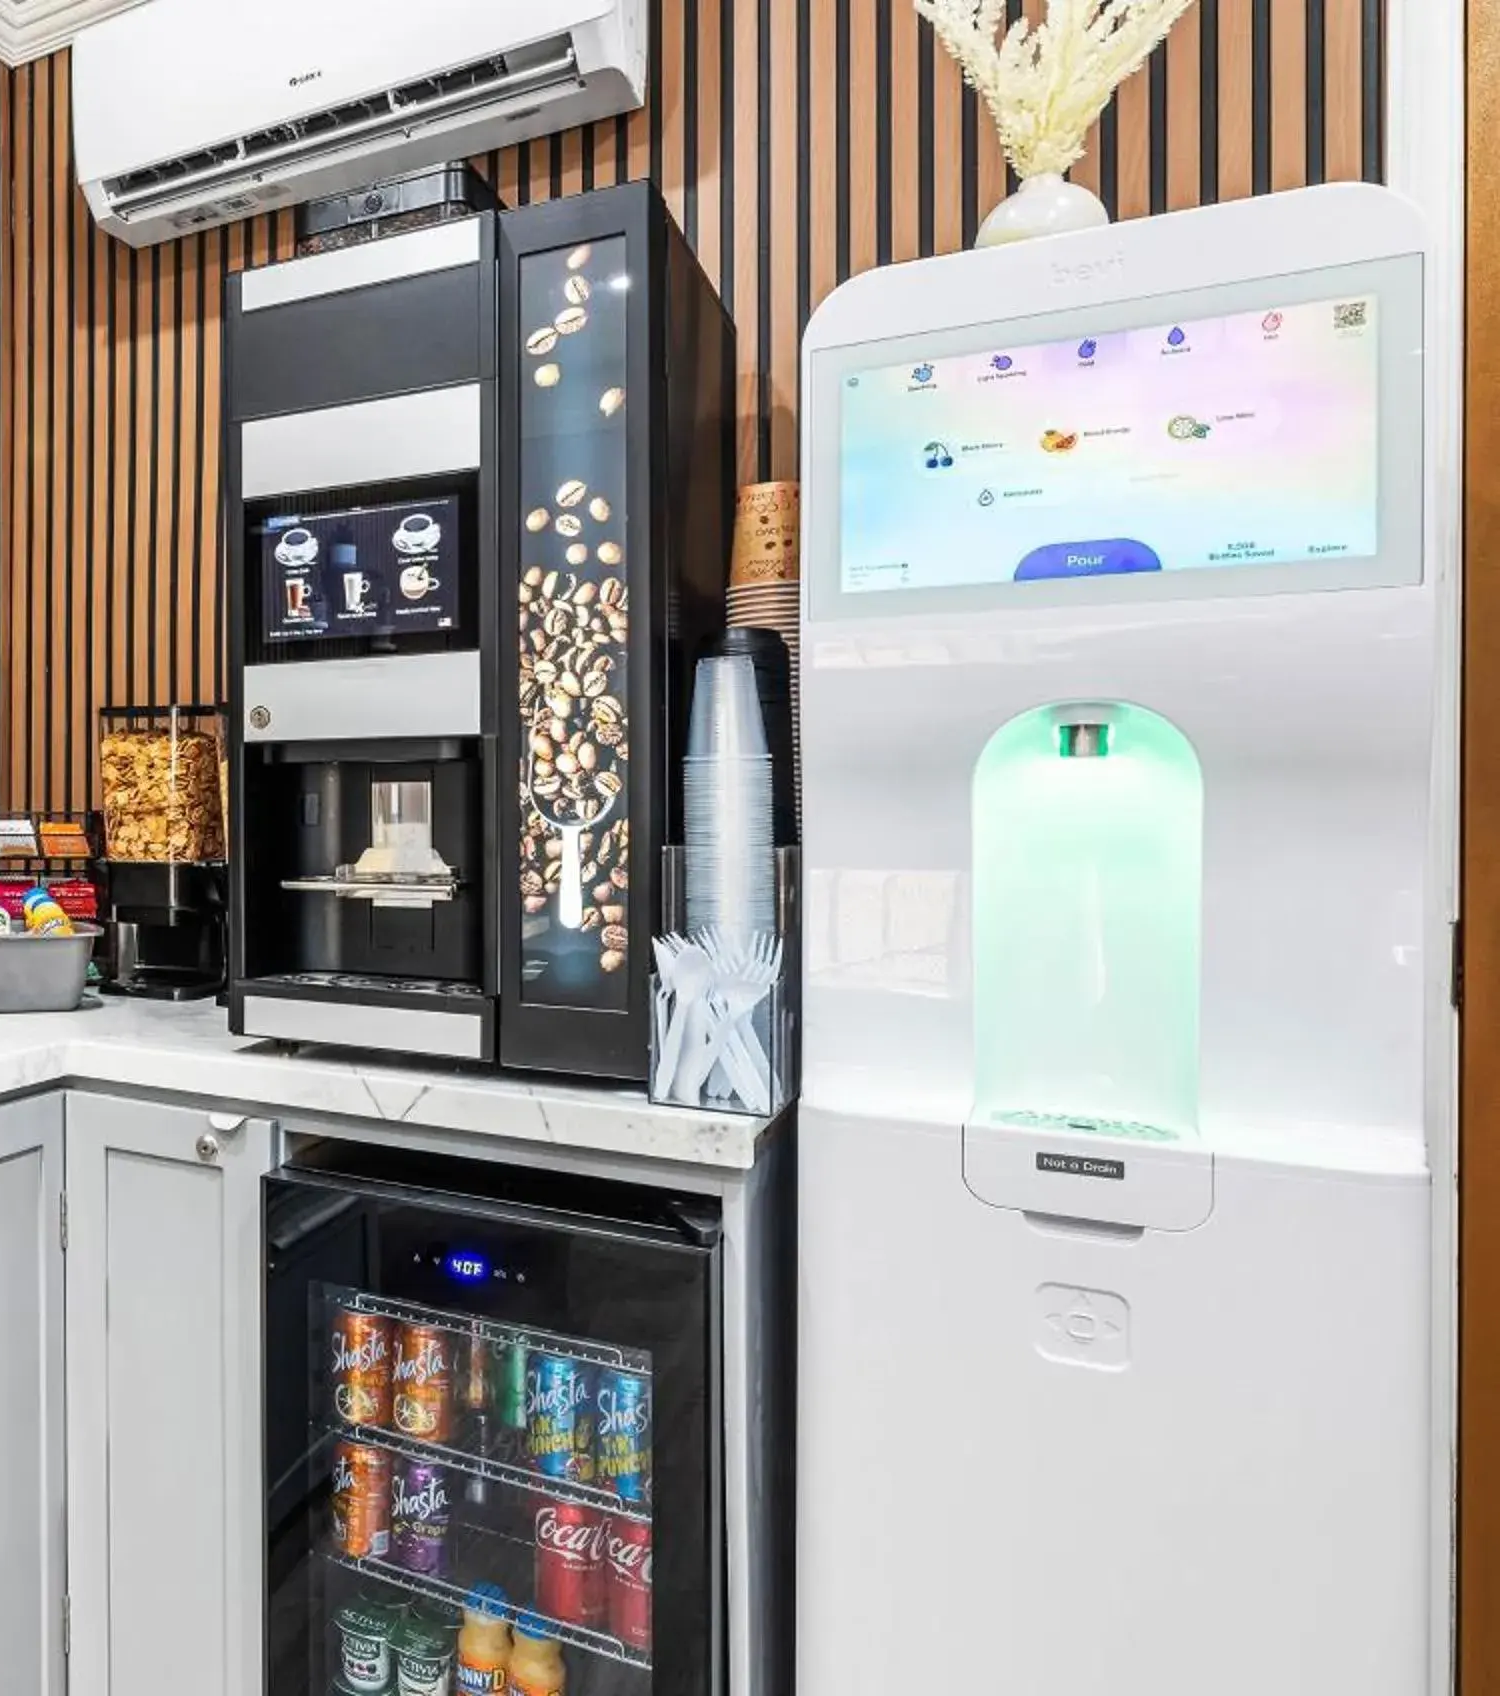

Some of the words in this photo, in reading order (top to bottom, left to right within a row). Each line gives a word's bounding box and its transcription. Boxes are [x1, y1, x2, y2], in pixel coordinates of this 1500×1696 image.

[1067, 553, 1106, 567] Pour
[1043, 1157, 1067, 1169] Not
[1070, 1162, 1079, 1170] a
[1083, 1161, 1117, 1175] Drain
[331, 1329, 388, 1373] Shasta
[527, 1370, 591, 1416] Shasta
[598, 1389, 648, 1437] Shas
[391, 1474, 450, 1520] Shasta
[412, 1521, 448, 1536] Grape
